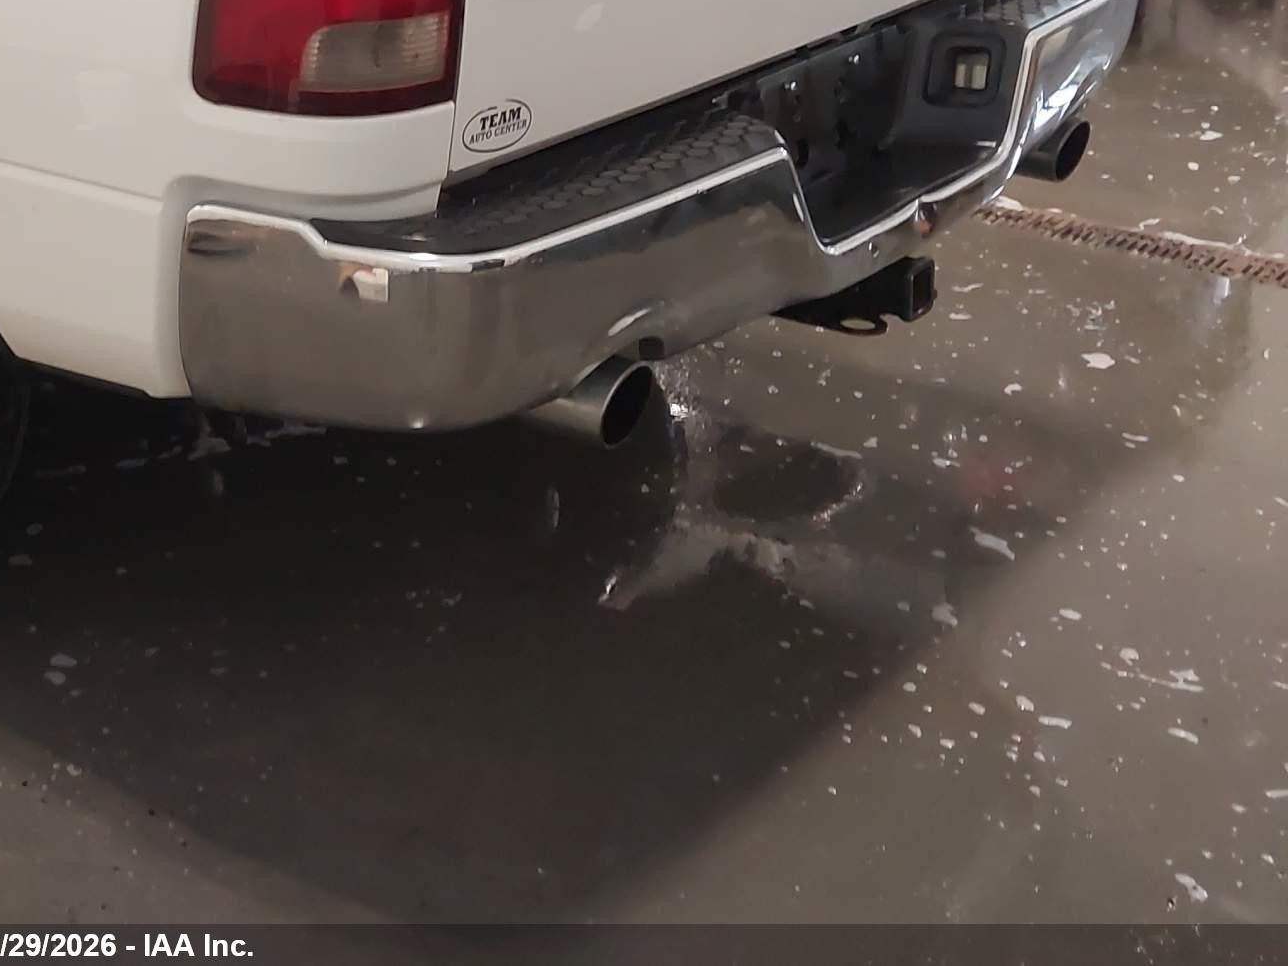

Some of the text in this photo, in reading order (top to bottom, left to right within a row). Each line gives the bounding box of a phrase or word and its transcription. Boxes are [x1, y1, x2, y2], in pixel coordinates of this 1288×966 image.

[480, 106, 522, 131] TEAM
[469, 119, 527, 145] AUTO CENTER
